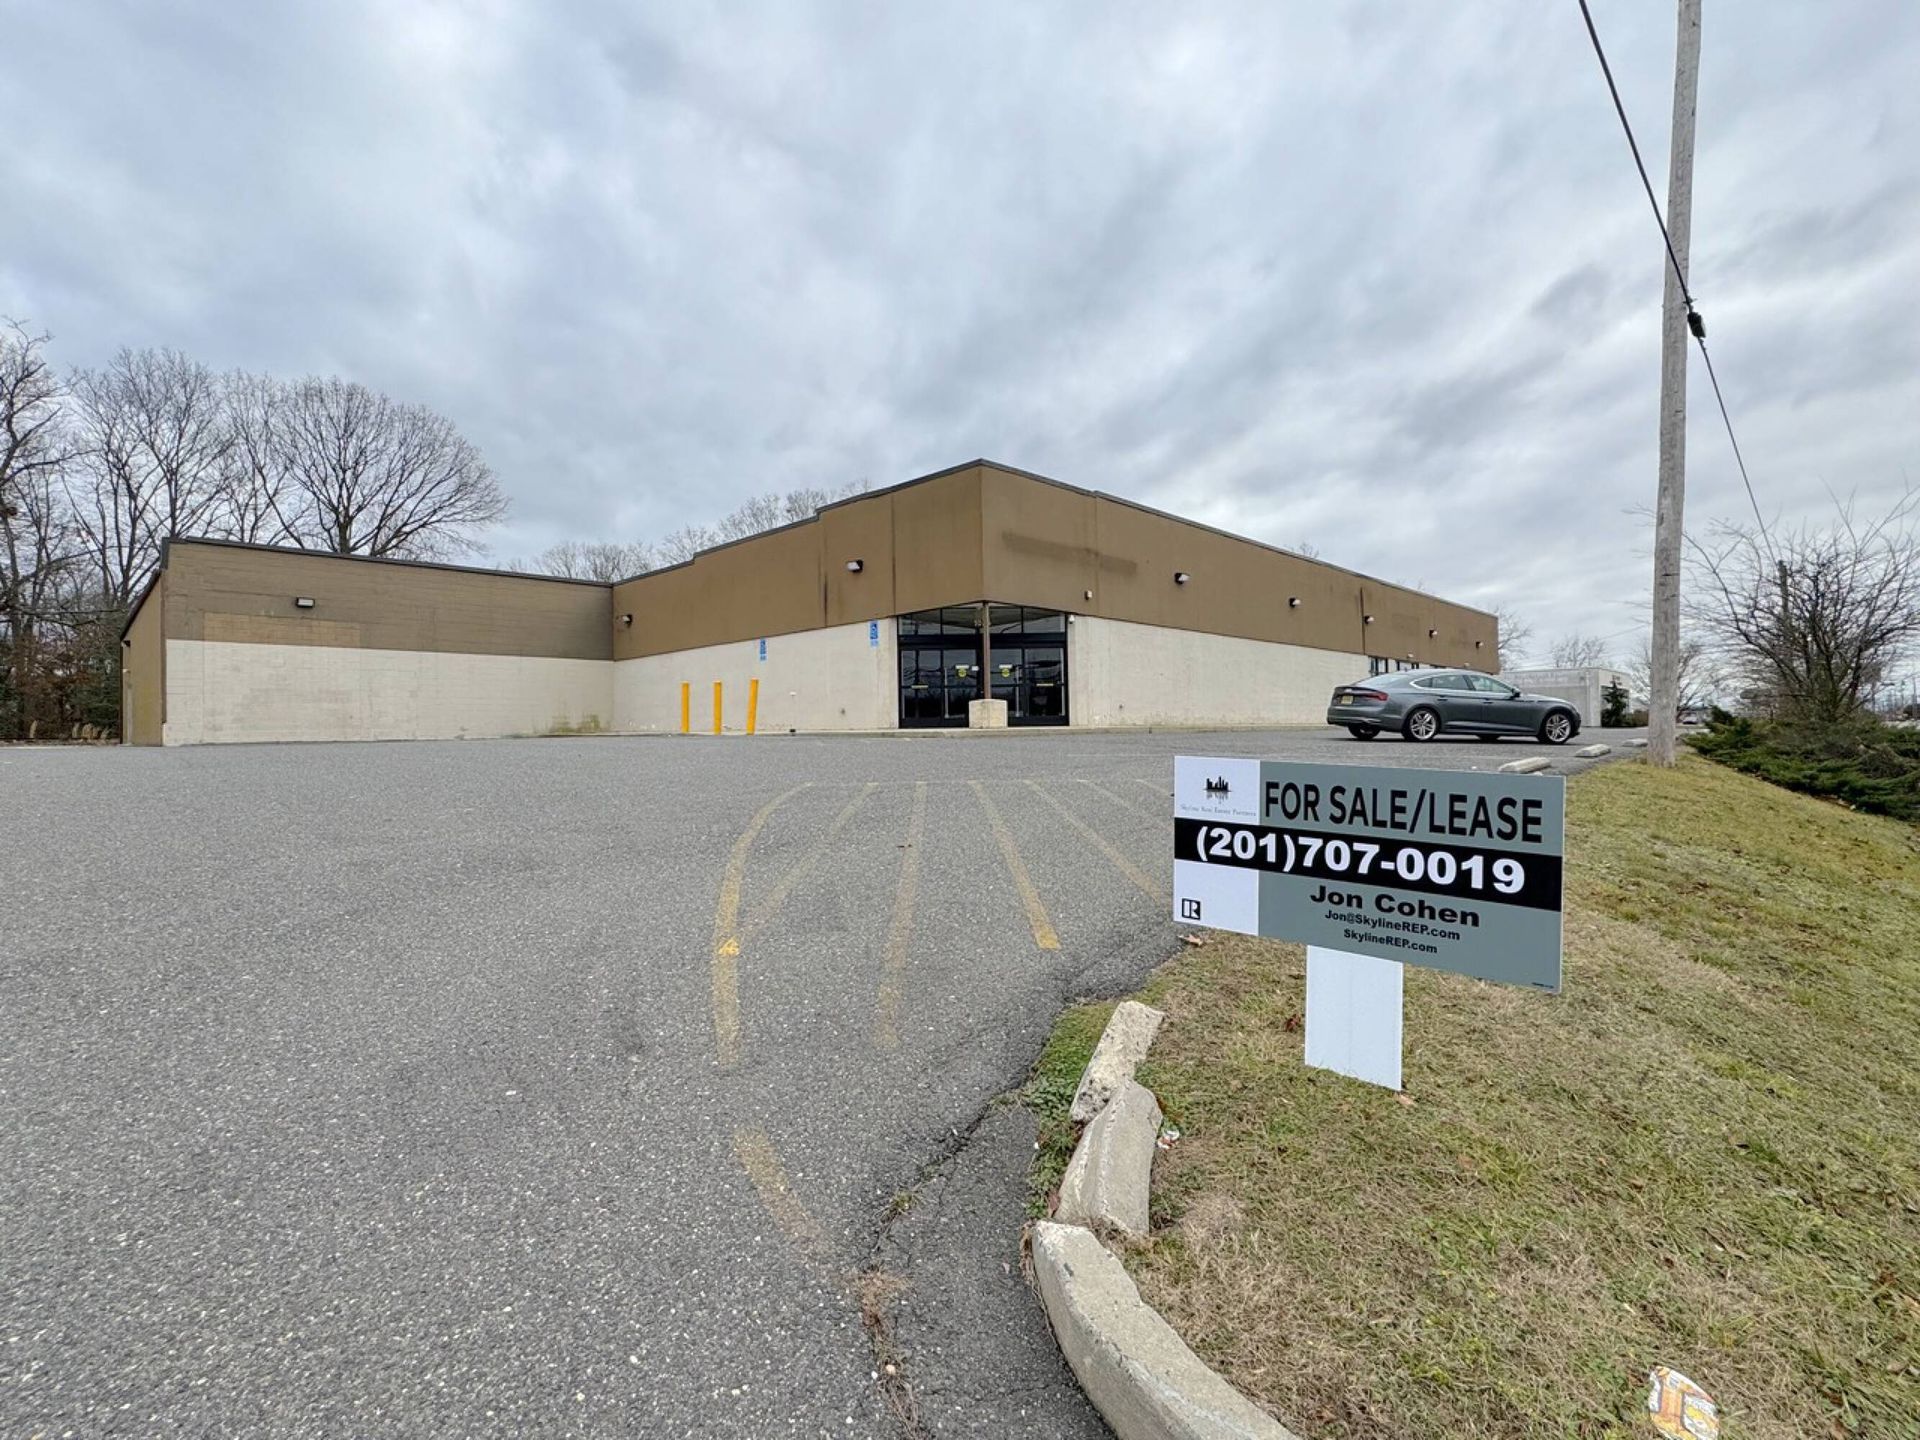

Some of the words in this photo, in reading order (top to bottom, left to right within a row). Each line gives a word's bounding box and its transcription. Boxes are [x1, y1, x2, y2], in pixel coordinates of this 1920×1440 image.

[1265, 781, 1320, 822] FOR
[1329, 786, 1543, 843] SALE/LEASE
[1196, 826, 1525, 894] (201)707-0019
[1310, 885, 1363, 909] Jon
[1375, 893, 1480, 927] Cohen
[1324, 910, 1460, 941] Jon@SkylineREP.com
[1343, 928, 1438, 954] SkylineREP.com
